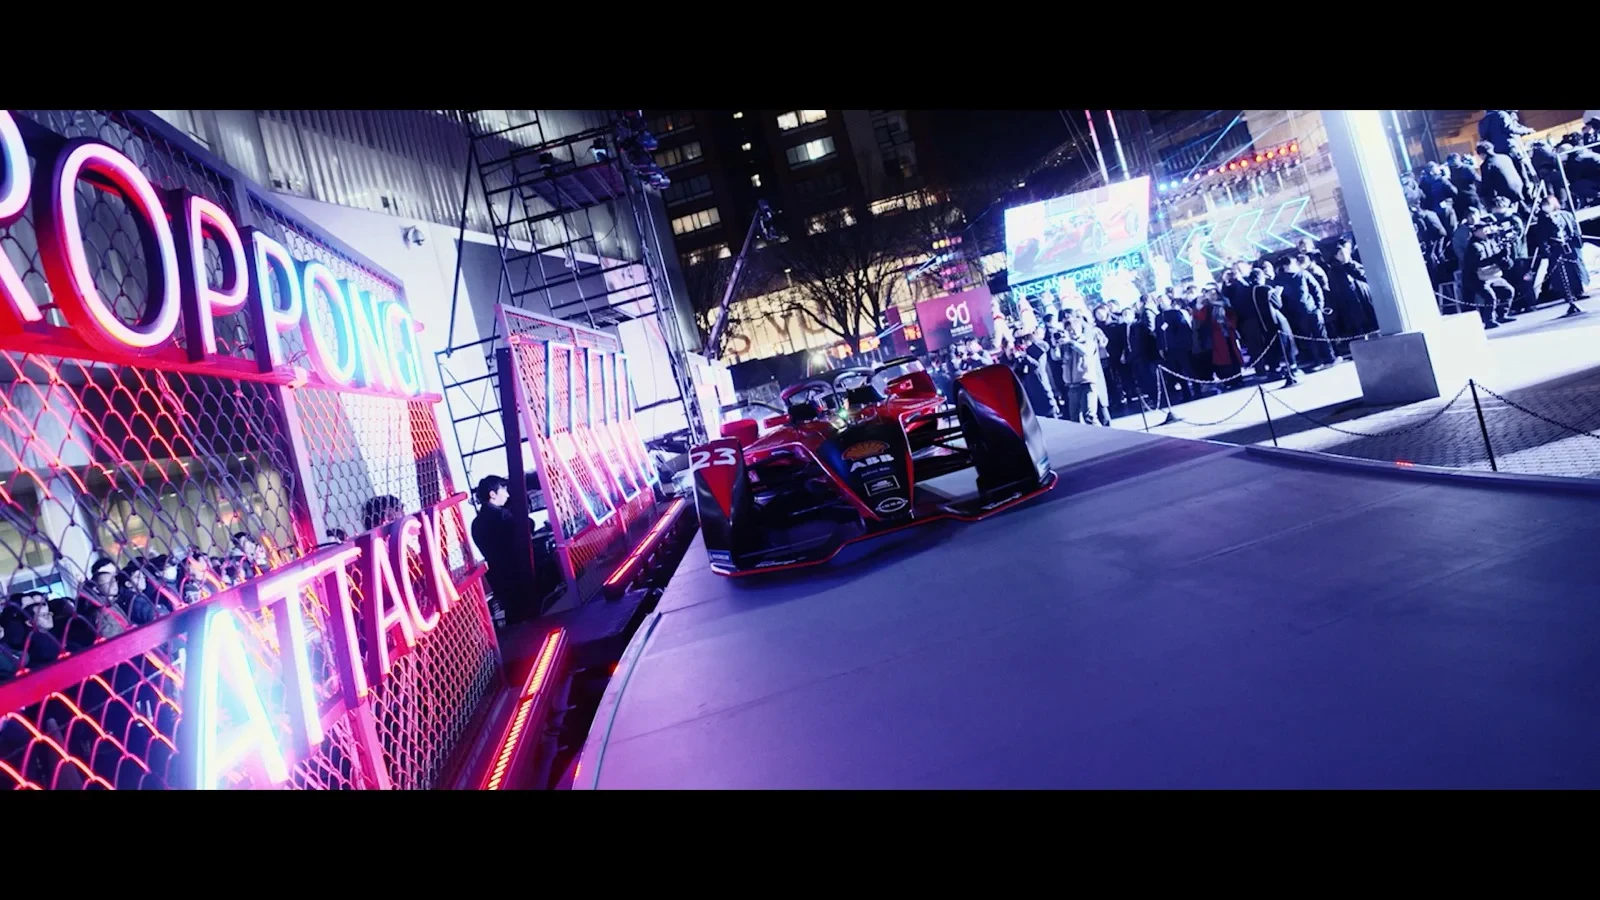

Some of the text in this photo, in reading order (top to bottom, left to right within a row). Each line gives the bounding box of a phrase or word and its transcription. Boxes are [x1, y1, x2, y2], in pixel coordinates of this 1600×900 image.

[945, 301, 971, 328] 90
[689, 447, 737, 472] 23
[849, 454, 895, 473] ABB
[195, 502, 461, 790] ATTACK
